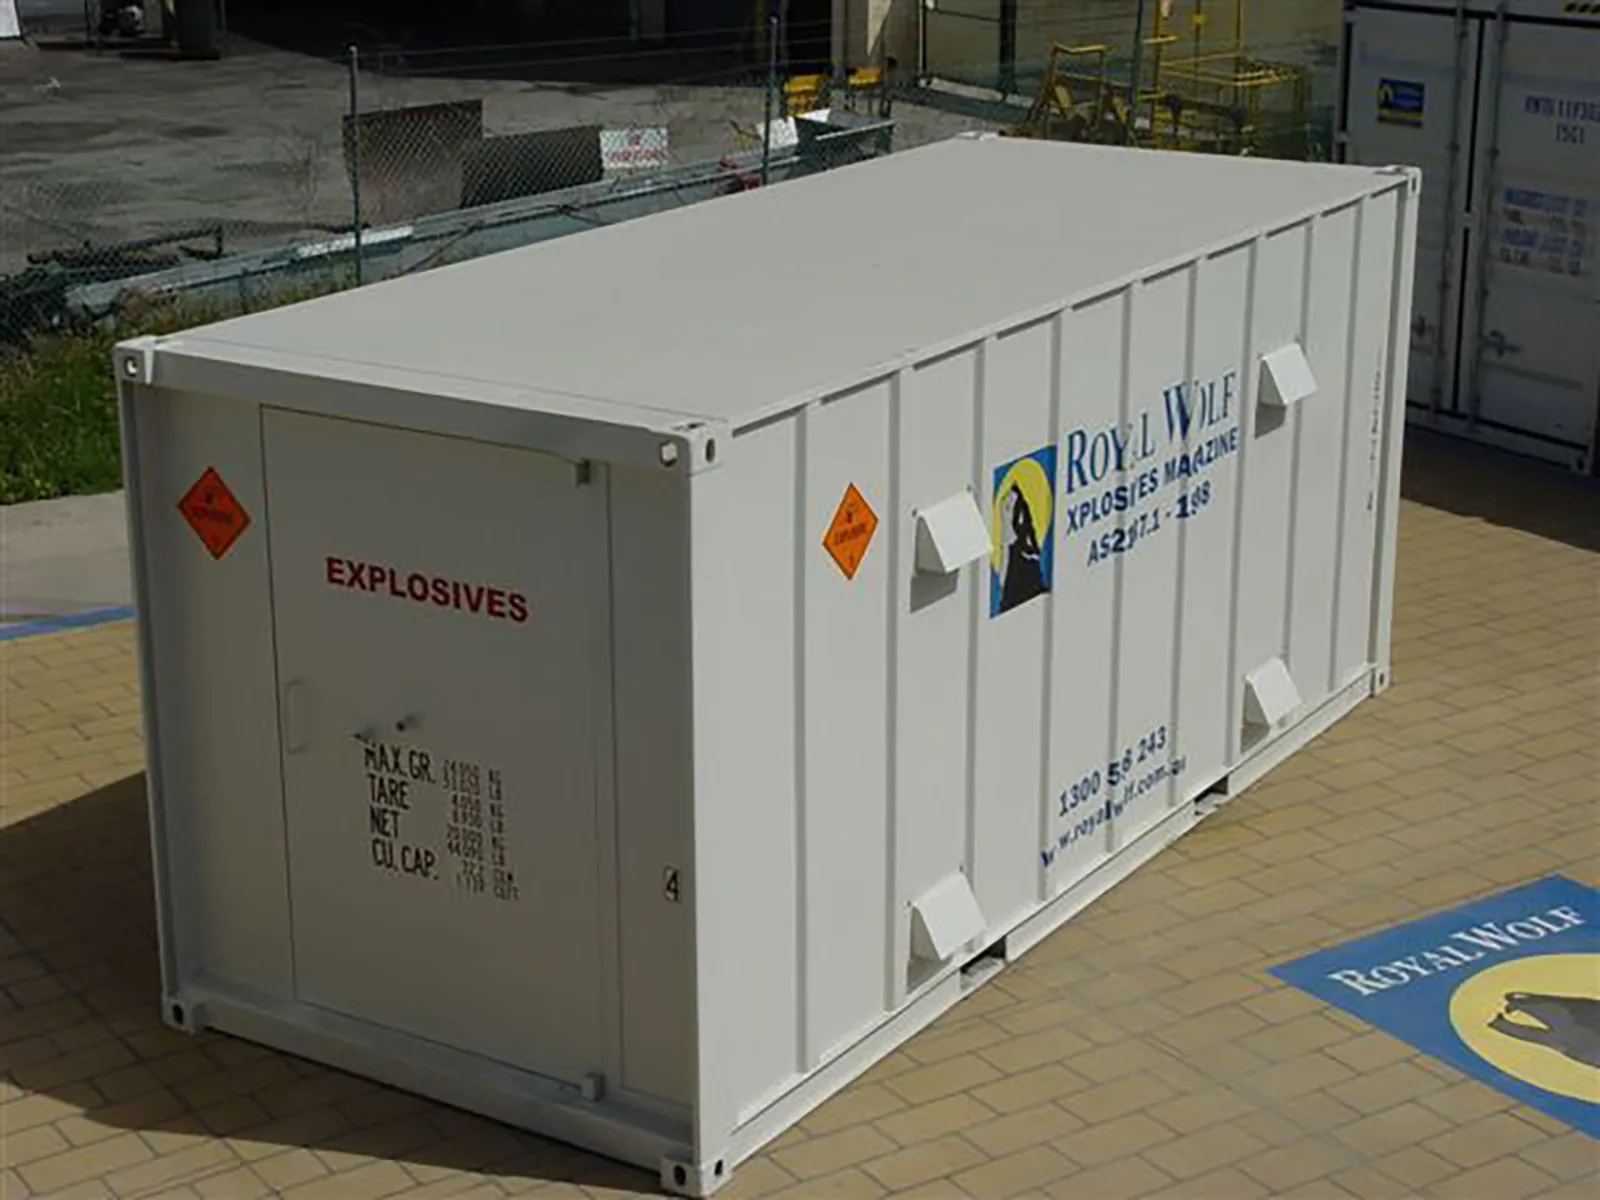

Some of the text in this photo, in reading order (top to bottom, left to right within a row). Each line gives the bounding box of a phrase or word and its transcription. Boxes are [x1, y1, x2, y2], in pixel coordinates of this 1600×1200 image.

[1066, 412, 1156, 494] ROYL
[326, 556, 529, 624] EXPLOSIVES
[367, 772, 411, 810] TARE
[1059, 770, 1101, 817] 1300
[369, 803, 400, 838] NET
